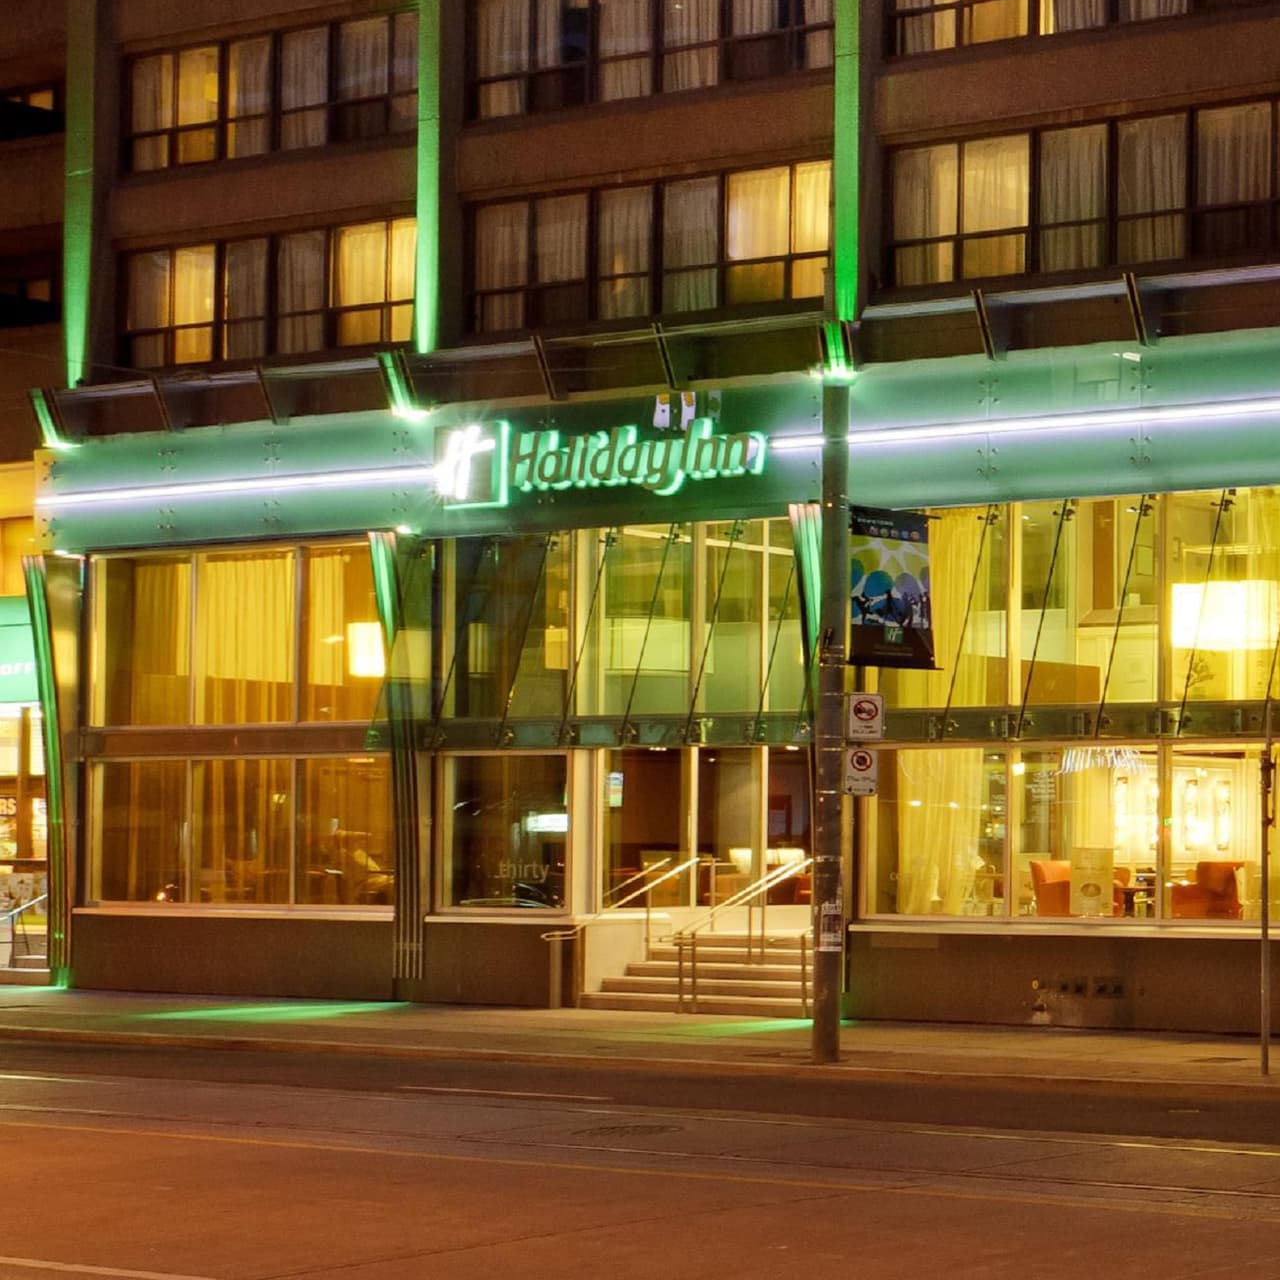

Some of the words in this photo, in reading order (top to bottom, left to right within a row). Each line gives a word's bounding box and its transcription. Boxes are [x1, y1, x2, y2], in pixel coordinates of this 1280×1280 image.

[509, 424, 685, 496] Holiday
[680, 417, 767, 479] Inn
[499, 860, 550, 883] thirty
